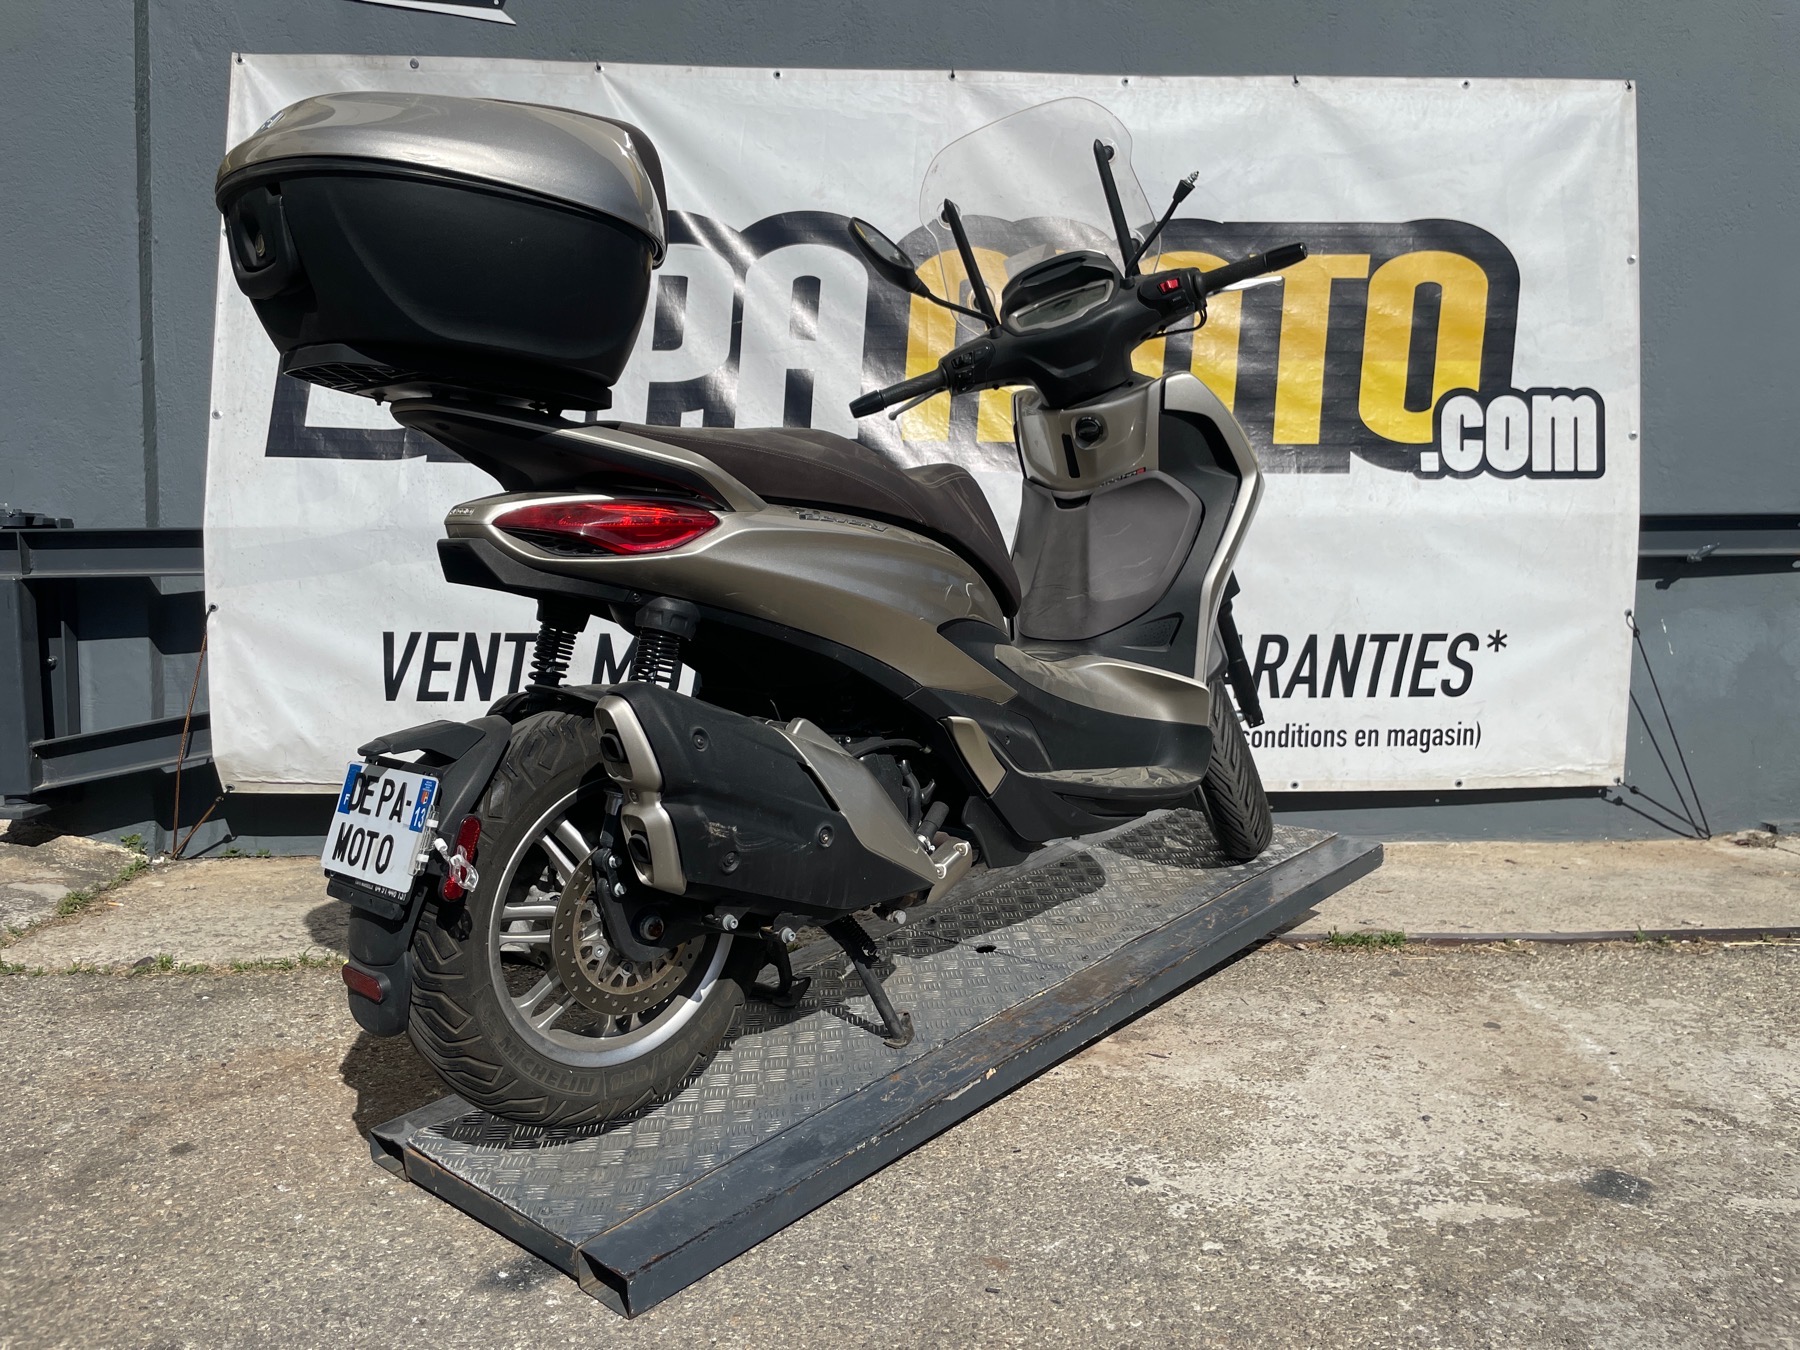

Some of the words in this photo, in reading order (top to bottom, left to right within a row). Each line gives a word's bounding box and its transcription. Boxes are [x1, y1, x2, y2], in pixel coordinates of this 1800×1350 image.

[382, 631, 540, 702] VENT
[1223, 629, 1508, 699] RANTIES
[1354, 729, 1379, 747] en
[1386, 721, 1482, 753] magasin)
[343, 793, 351, 805] F
[413, 806, 426, 828] 13
[332, 822, 394, 875] MOTO
[498, 1036, 598, 1093] MICHELIN
